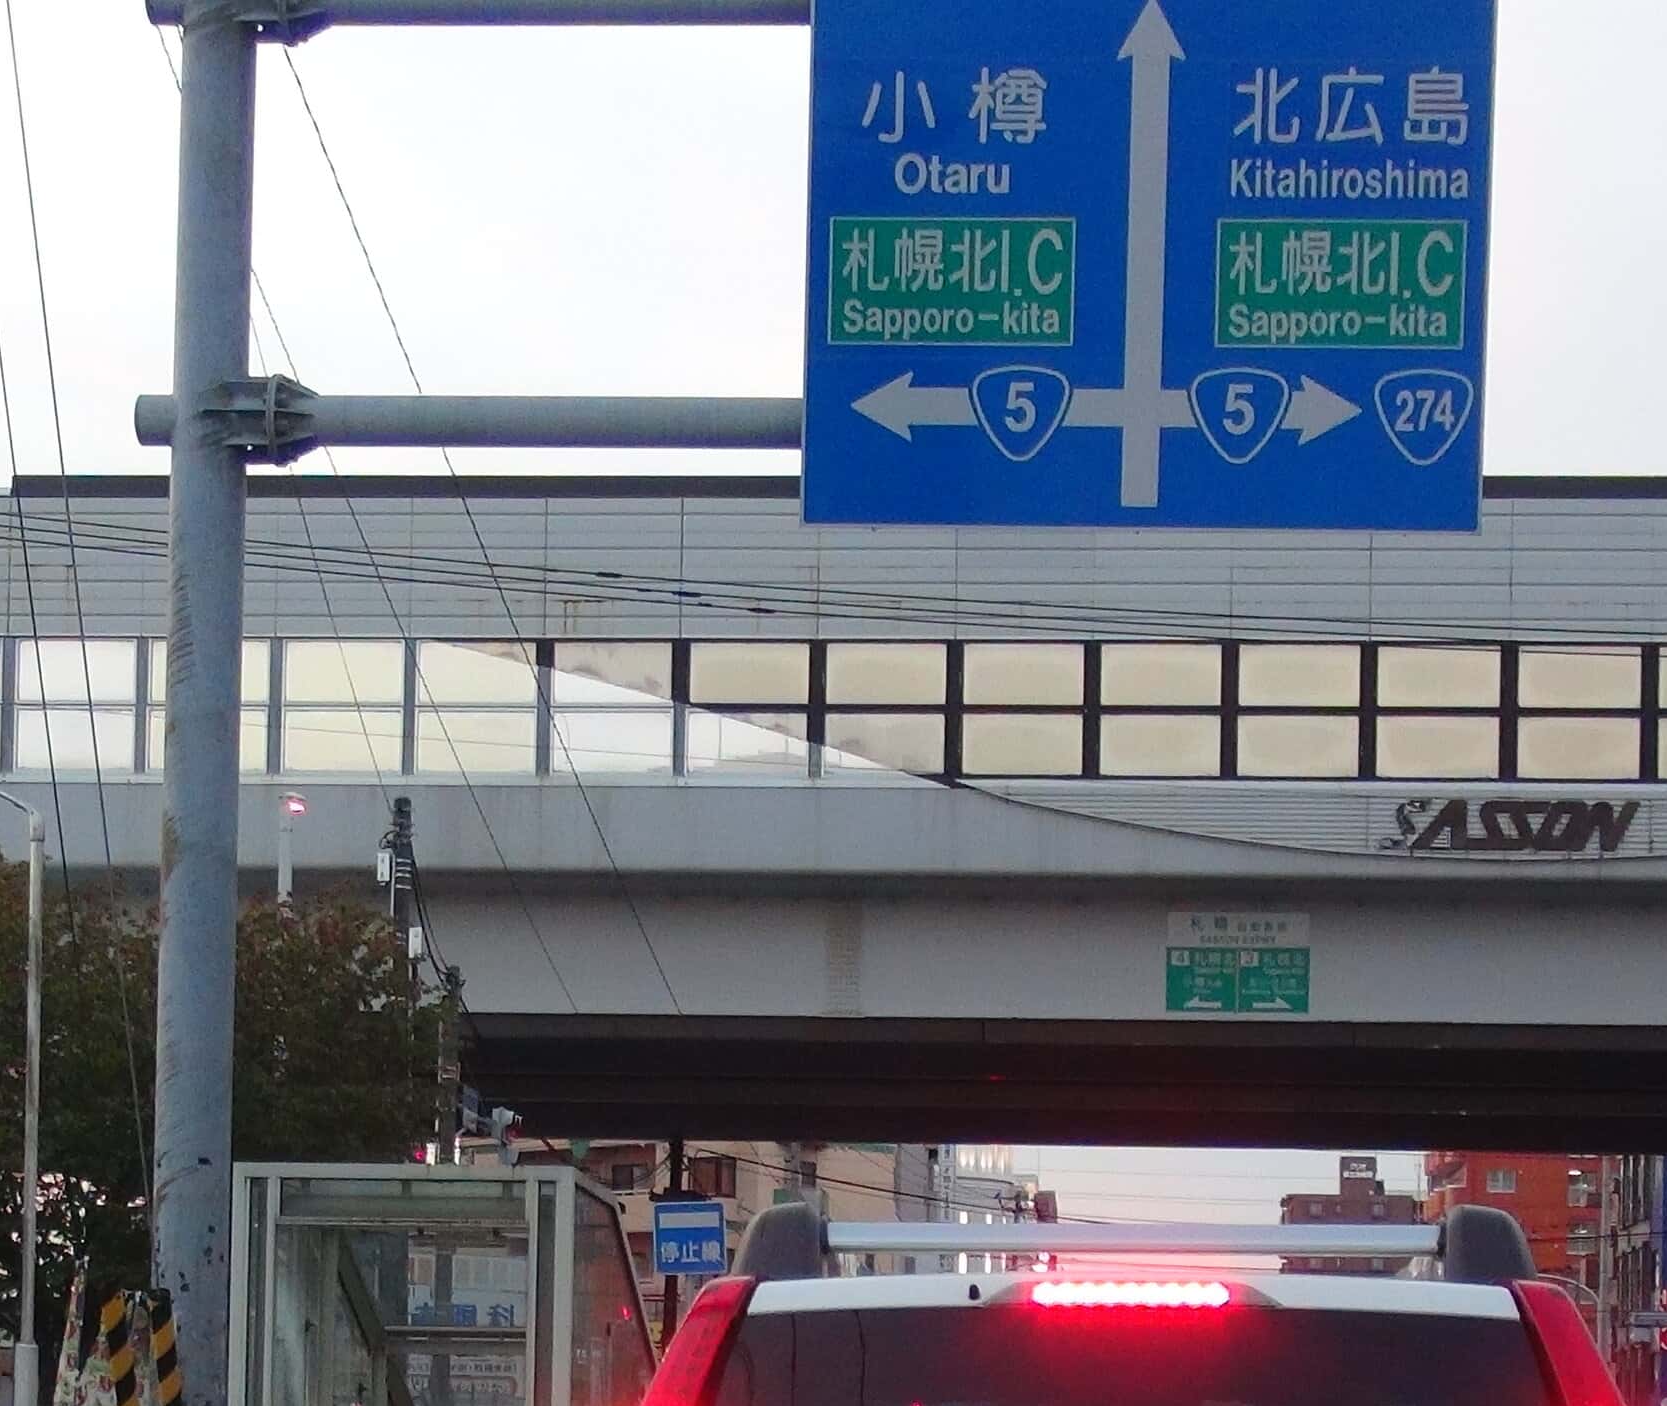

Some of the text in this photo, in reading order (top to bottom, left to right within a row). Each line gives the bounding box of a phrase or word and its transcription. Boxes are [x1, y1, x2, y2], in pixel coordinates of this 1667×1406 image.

[861, 66, 1048, 145] 小樽
[1233, 65, 1469, 146] 北広島
[894, 152, 1011, 195] Otaru
[1230, 158, 1470, 200] Kitahiroshima
[842, 299, 1062, 341] Sapporo-kita
[1228, 303, 1447, 344] Sapporo-kita
[1004, 381, 1036, 432] 5
[1222, 384, 1255, 435] 5
[1395, 389, 1455, 433] 274
